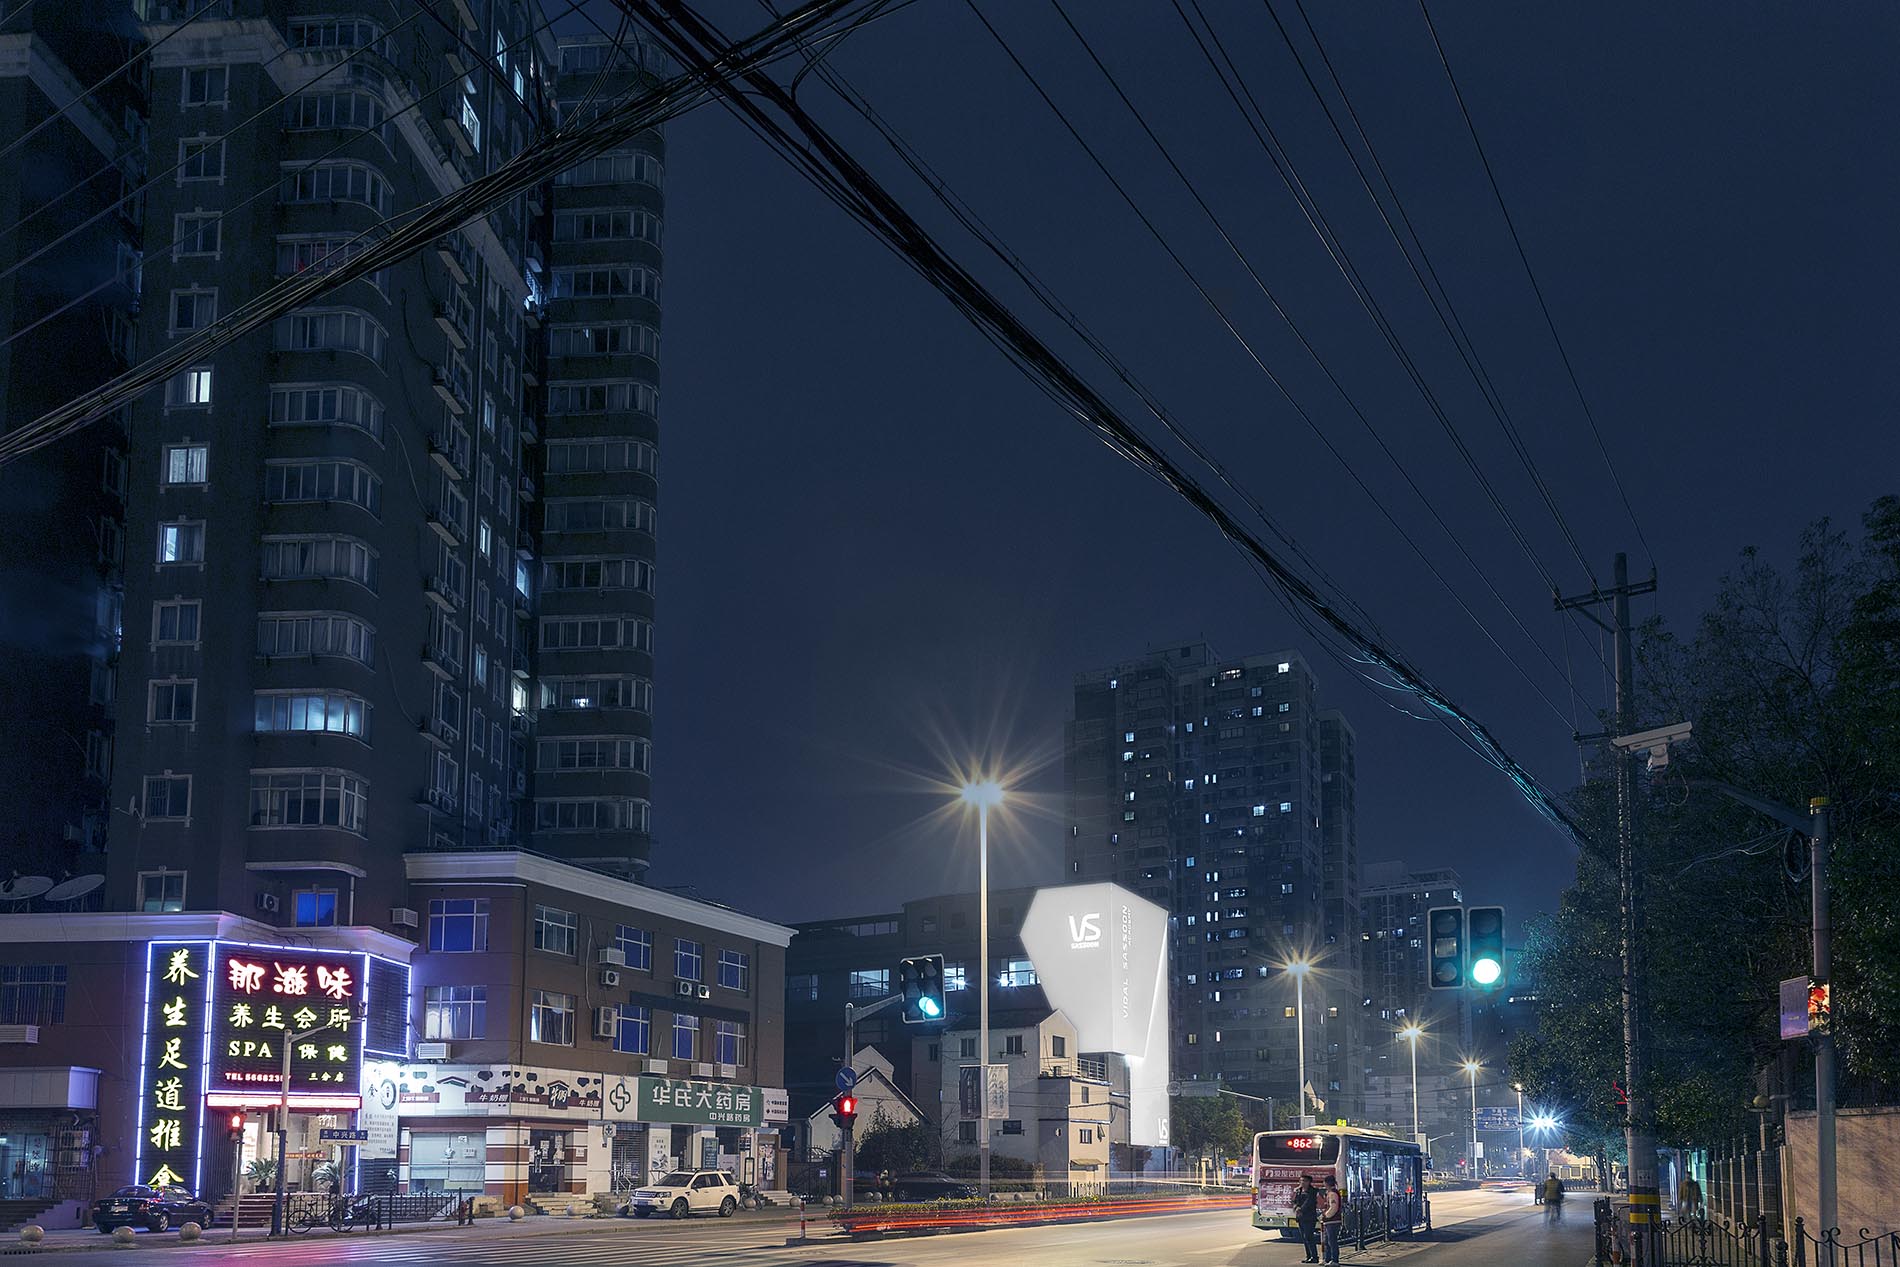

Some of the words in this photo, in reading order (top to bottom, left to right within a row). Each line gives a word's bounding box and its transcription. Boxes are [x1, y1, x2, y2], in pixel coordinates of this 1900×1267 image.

[1068, 913, 1101, 942] VS
[229, 1003, 351, 1031] 养生会所
[228, 1040, 272, 1057] SPA
[652, 1086, 751, 1111] 华氏大药房
[709, 1112, 751, 1122] 中兴路药房
[1293, 1138, 1312, 1149] 862
